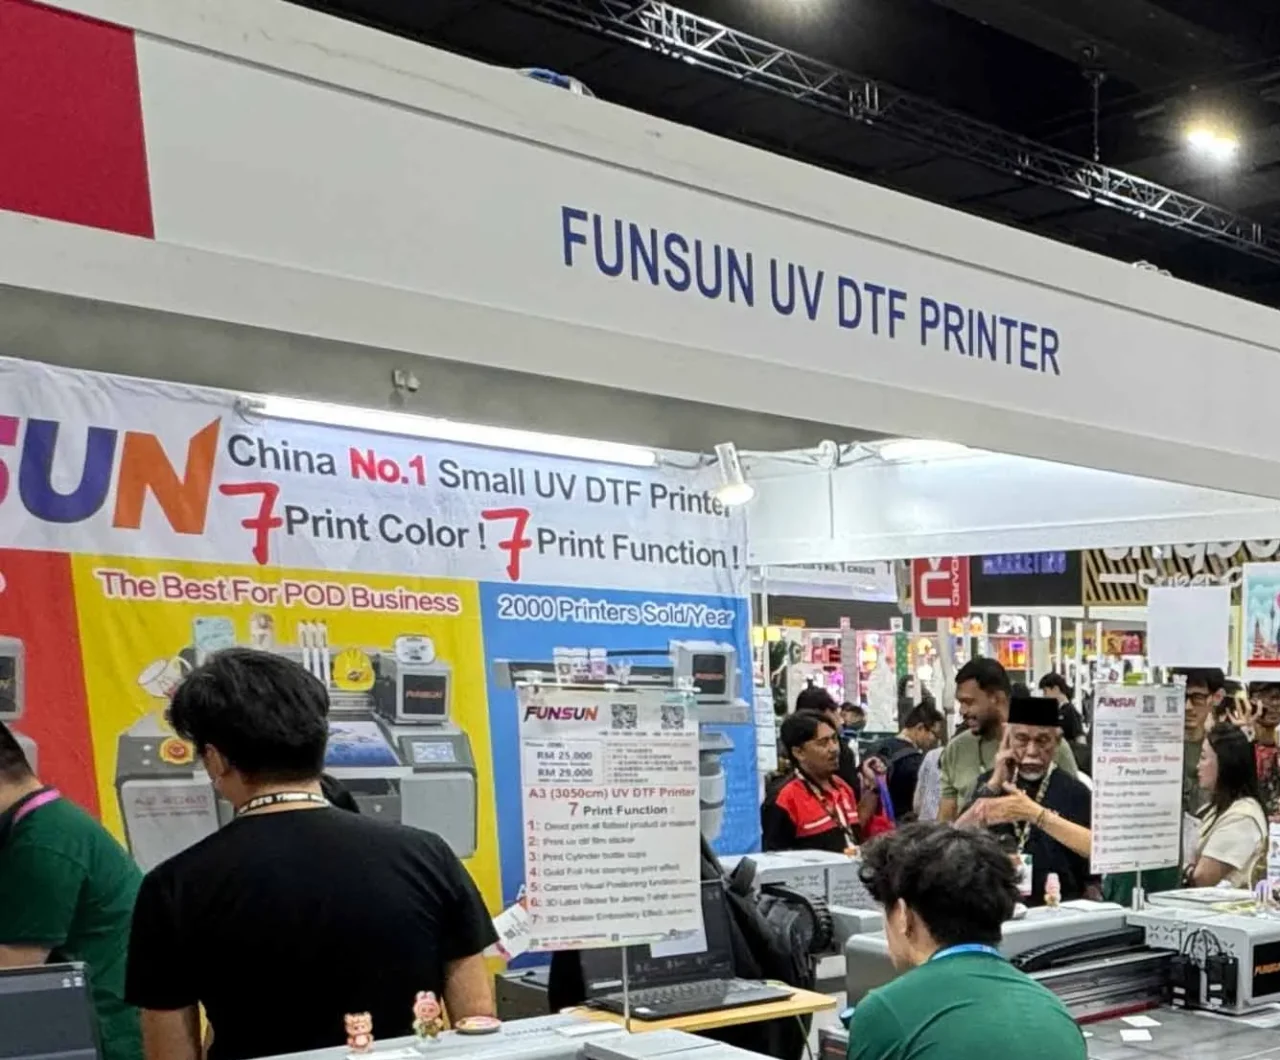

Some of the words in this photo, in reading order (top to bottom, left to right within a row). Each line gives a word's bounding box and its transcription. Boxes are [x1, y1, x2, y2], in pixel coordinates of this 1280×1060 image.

[562, 206, 754, 307] FUNSUN
[770, 258, 824, 321] UV
[838, 276, 907, 339] DTF
[921, 296, 1060, 375] PRINTER
[0, 415, 222, 535] UN
[228, 434, 337, 476] China
[349, 447, 427, 487] No.1
[439, 459, 525, 496] Small
[535, 470, 577, 500] UV
[586, 479, 642, 506] DTF
[219, 482, 283, 565] 7
[285, 505, 370, 542] Print
[379, 513, 470, 551] Color
[481, 508, 532, 582] 7
[538, 528, 606, 560] Print
[614, 534, 727, 569] Function
[98, 570, 156, 598] The
[164, 575, 227, 601] Best
[234, 579, 278, 602] For
[285, 581, 345, 608] POD
[352, 586, 460, 613] Business
[500, 596, 553, 620] 2000
[560, 600, 637, 625] Printers
[642, 605, 733, 630] Sold/Year
[523, 706, 598, 722] FUNSUN
[537, 751, 555, 759] RM
[538, 768, 555, 776] RM
[529, 788, 547, 799] A3
[612, 788, 628, 799] UV
[633, 788, 656, 798] DTF
[660, 787, 695, 798] Printer
[568, 802, 579, 816] 7
[583, 805, 613, 816] Print
[617, 805, 668, 815] Function
